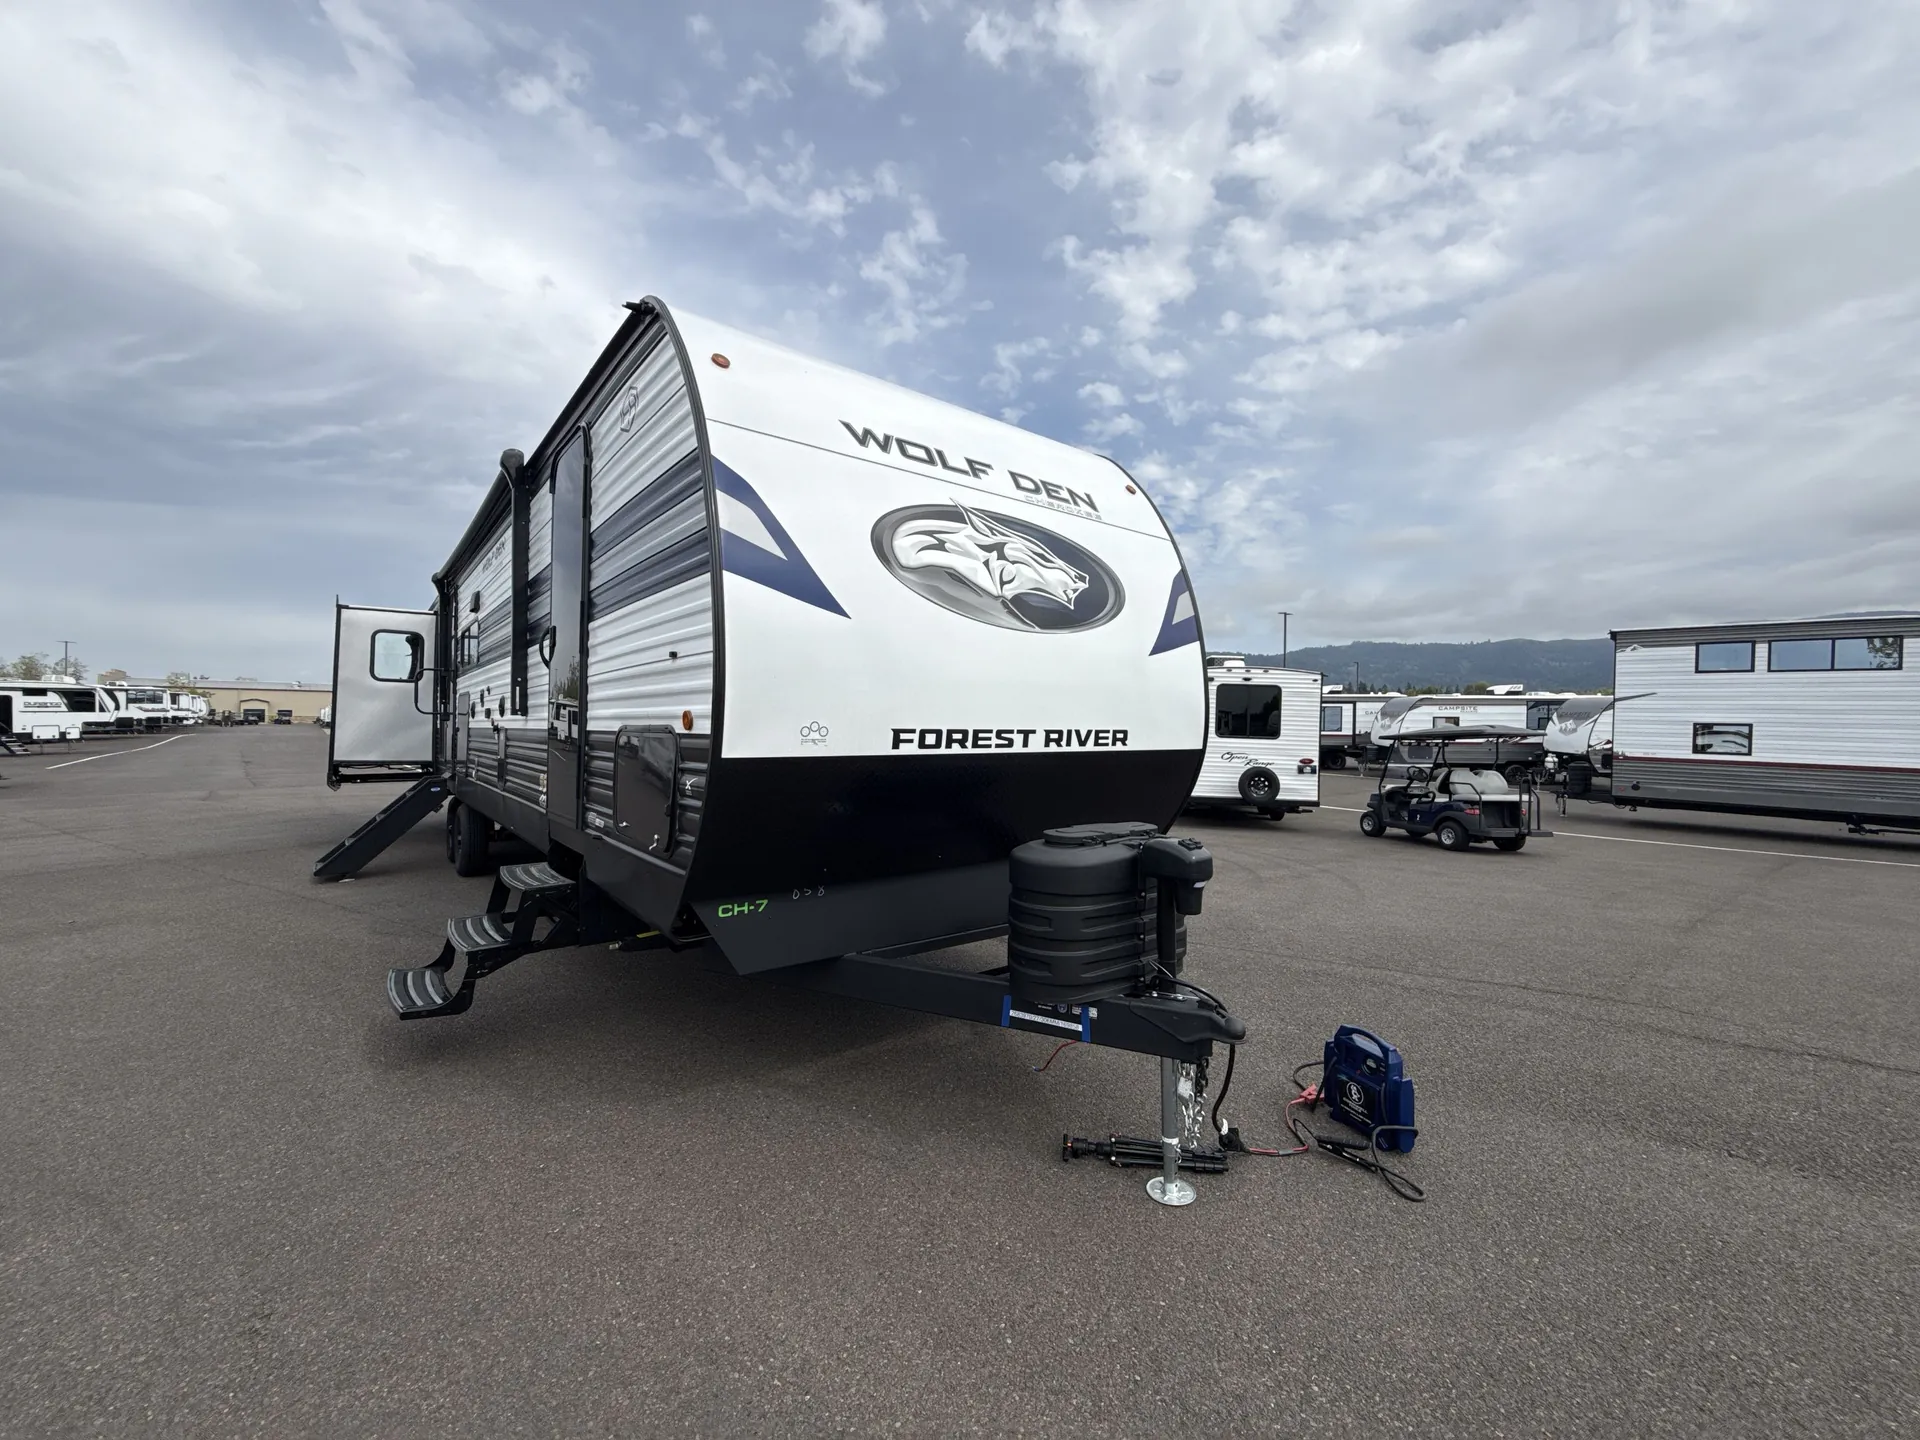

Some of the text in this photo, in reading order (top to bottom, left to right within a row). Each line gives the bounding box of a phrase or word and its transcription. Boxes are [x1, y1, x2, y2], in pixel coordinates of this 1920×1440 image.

[839, 419, 1100, 513] WOLF DEN
[891, 728, 1129, 750] FOREST RIVER
[1221, 751, 1275, 768] Open Range
[718, 899, 769, 918] CH-7
